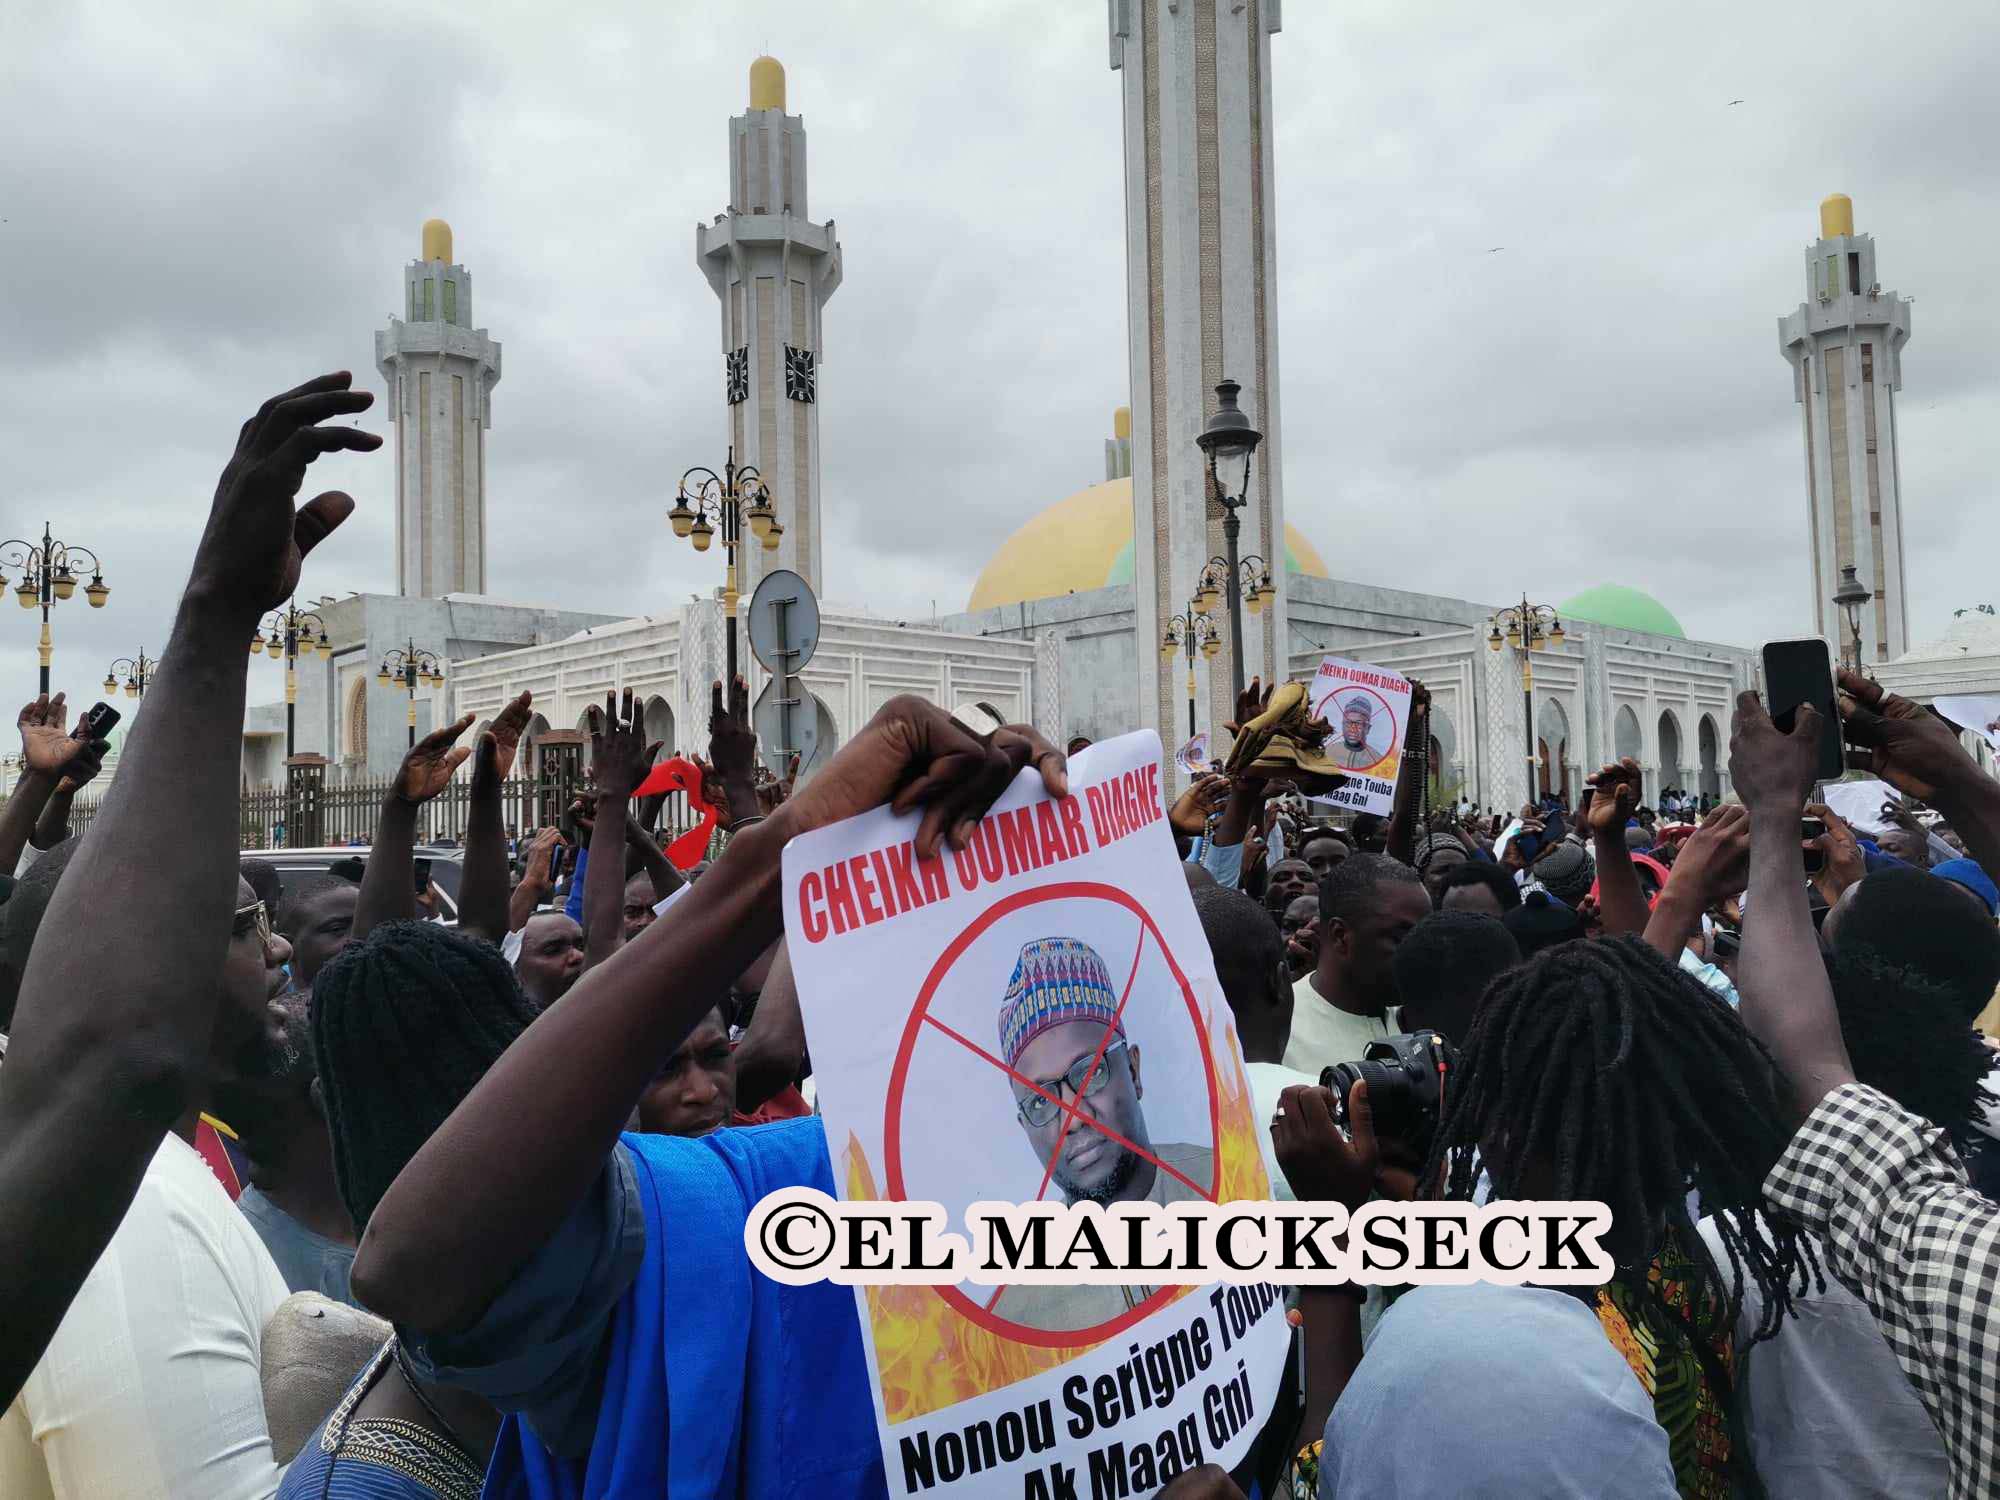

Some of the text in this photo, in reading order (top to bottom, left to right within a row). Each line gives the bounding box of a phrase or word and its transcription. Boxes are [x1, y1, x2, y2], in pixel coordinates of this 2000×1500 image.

[1350, 669, 1379, 686] OUMAR
[1352, 793, 1369, 807] Gni
[1365, 778, 1393, 796] Touba
[800, 840, 950, 943] CHEIKH
[1085, 763, 1162, 848] DIAGNE
[899, 1398, 1056, 1494] Nonou
[1063, 1317, 1212, 1440] Serigne
[1203, 1359, 1254, 1450] Gni
